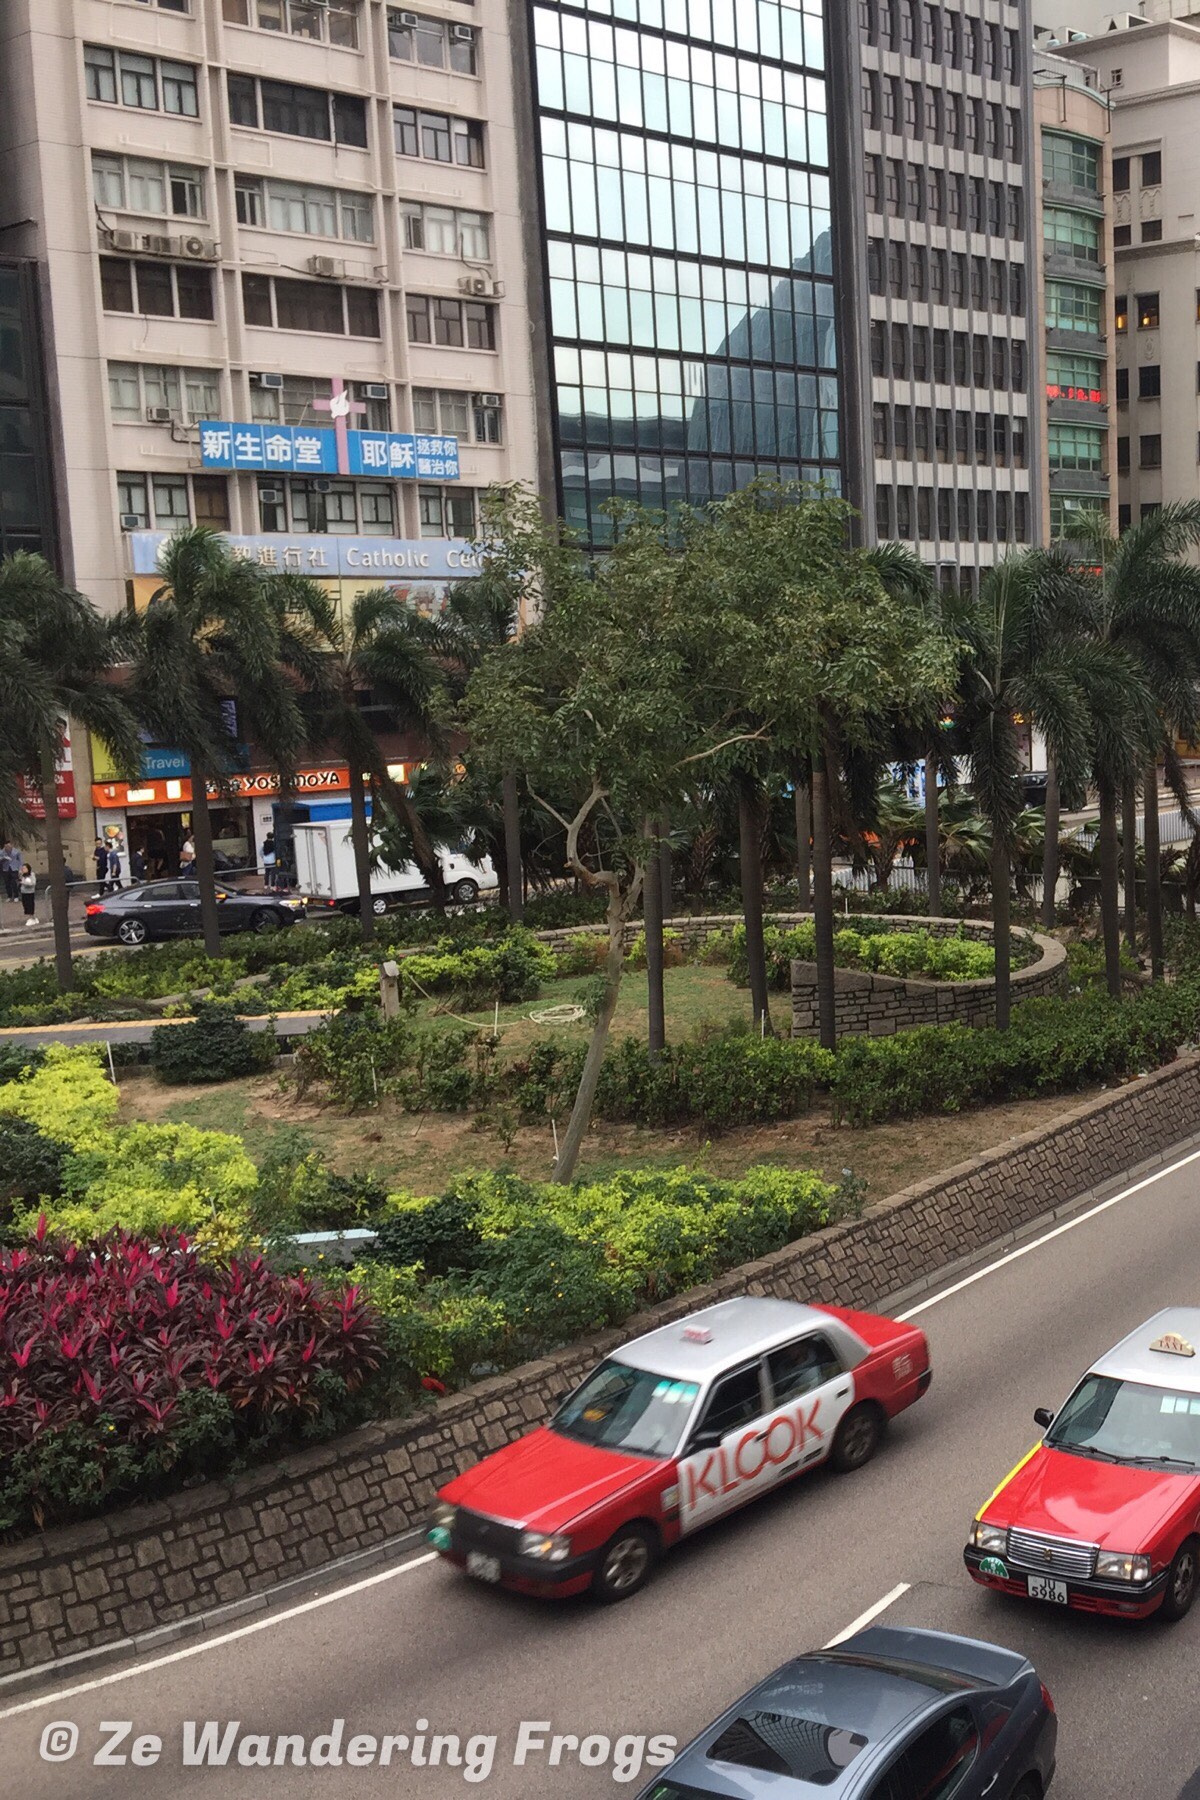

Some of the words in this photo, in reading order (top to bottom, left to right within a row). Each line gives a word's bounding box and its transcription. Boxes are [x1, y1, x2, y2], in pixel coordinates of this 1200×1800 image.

[203, 429, 322, 465] 新生命堂
[416, 438, 457, 456] 拯救你
[418, 458, 458, 476] 醫治你
[346, 548, 430, 568] Catholic
[145, 756, 186, 770] Travel
[1160, 1340, 1183, 1351] TAXI
[683, 1398, 826, 1512] KLOOK
[1040, 1578, 1056, 1591] JU
[1032, 1586, 1065, 1602] 5986
